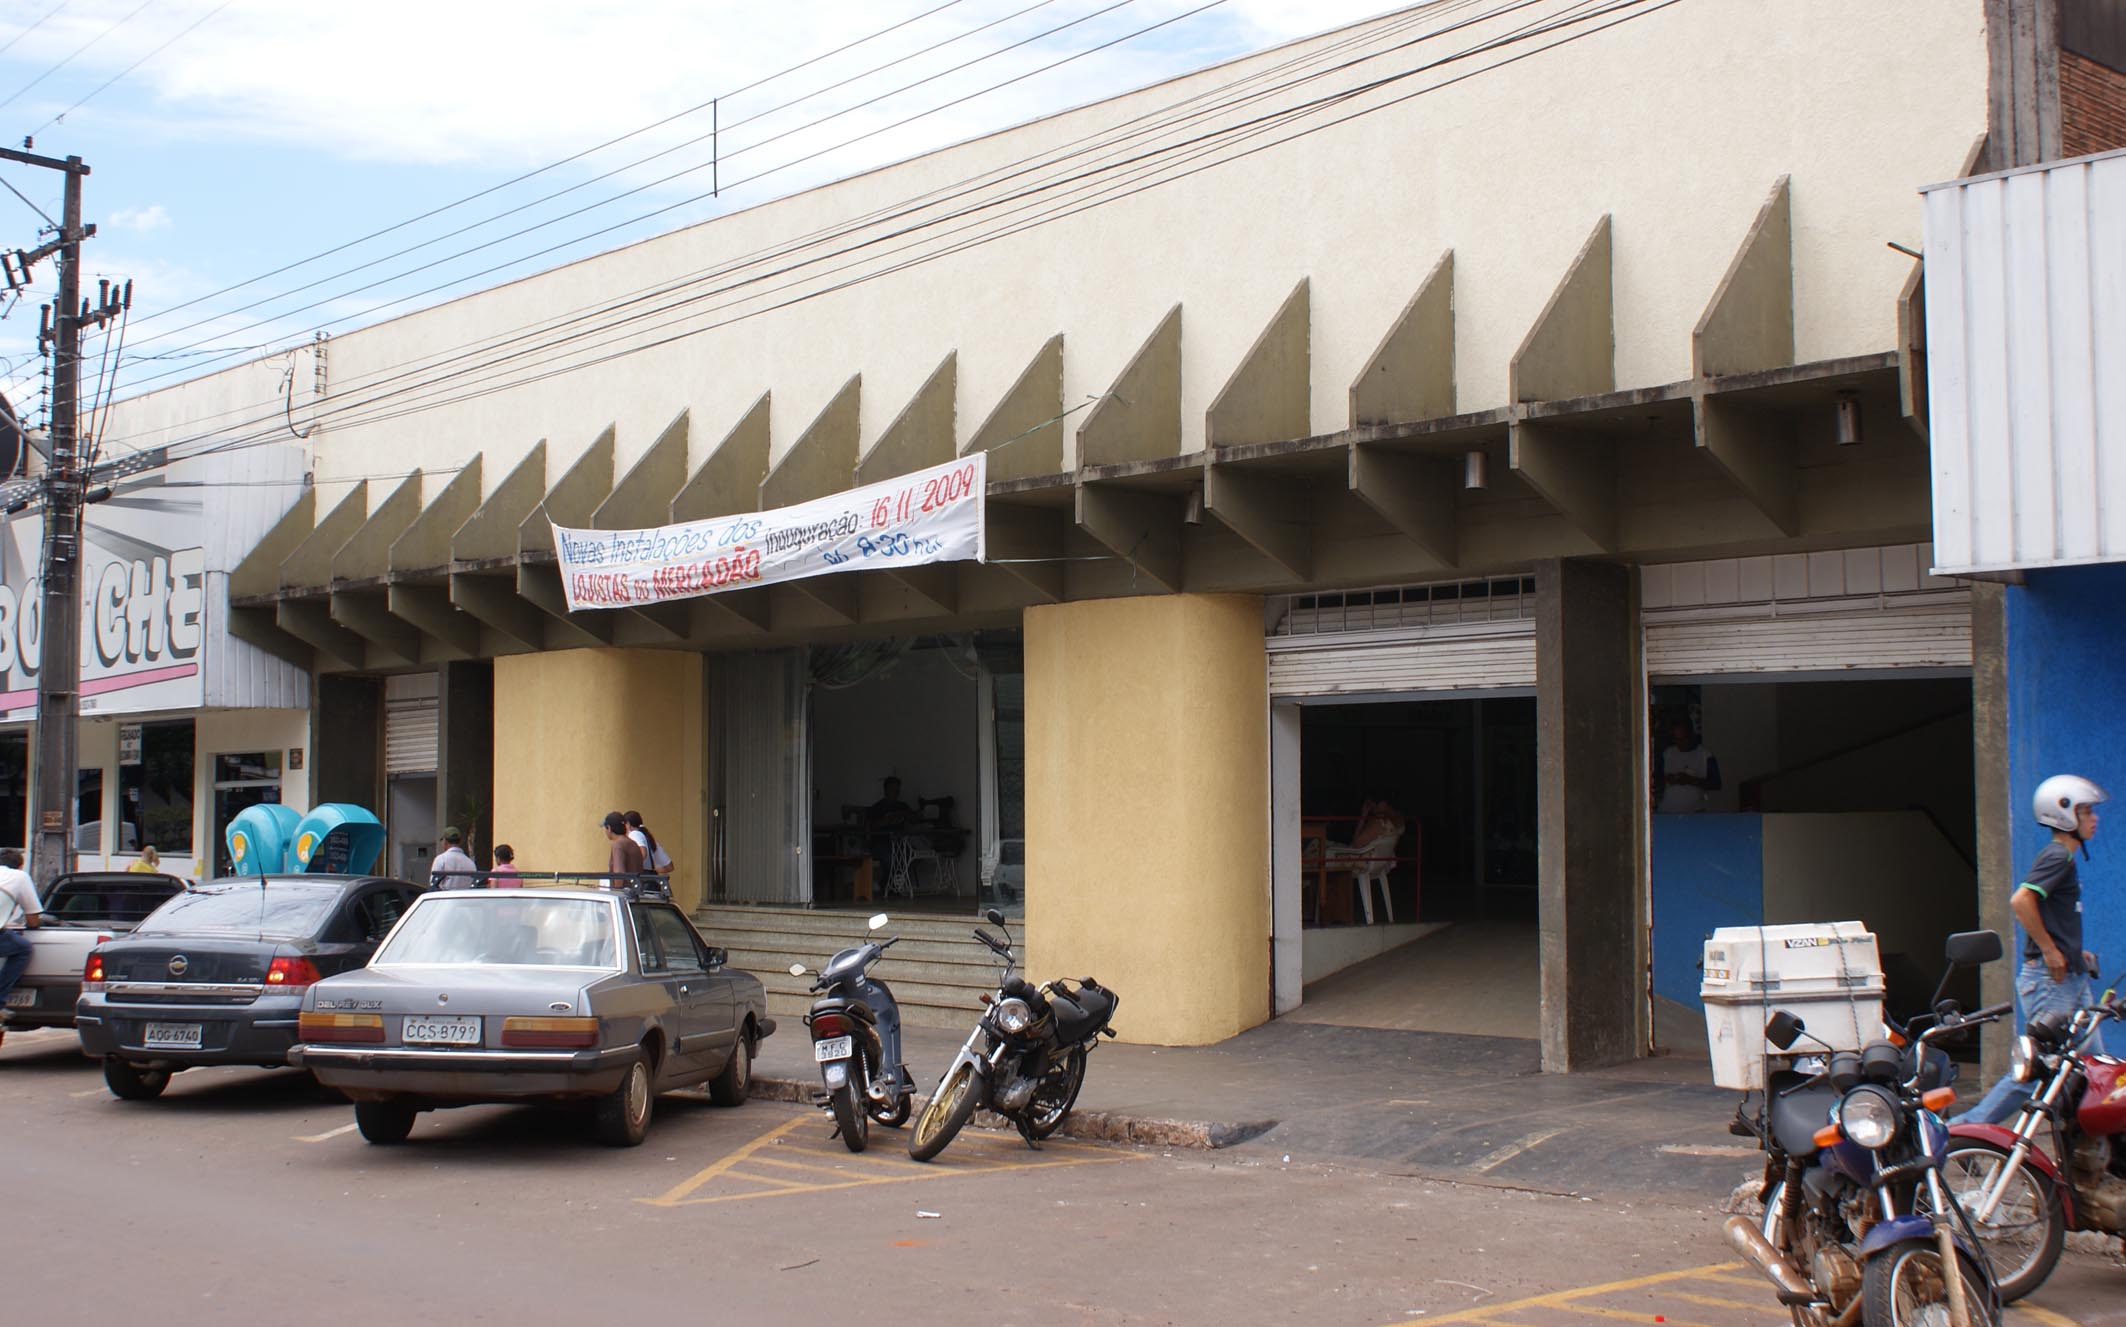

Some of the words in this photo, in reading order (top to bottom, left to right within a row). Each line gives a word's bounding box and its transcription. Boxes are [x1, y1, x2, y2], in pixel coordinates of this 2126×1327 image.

[561, 532, 605, 564] Novas
[610, 527, 712, 563] Instalações
[717, 519, 762, 548] dos
[571, 572, 632, 603] LOJISTAS
[652, 546, 761, 600] MERCADÃO
[406, 1024, 476, 1041] CCS-8799
